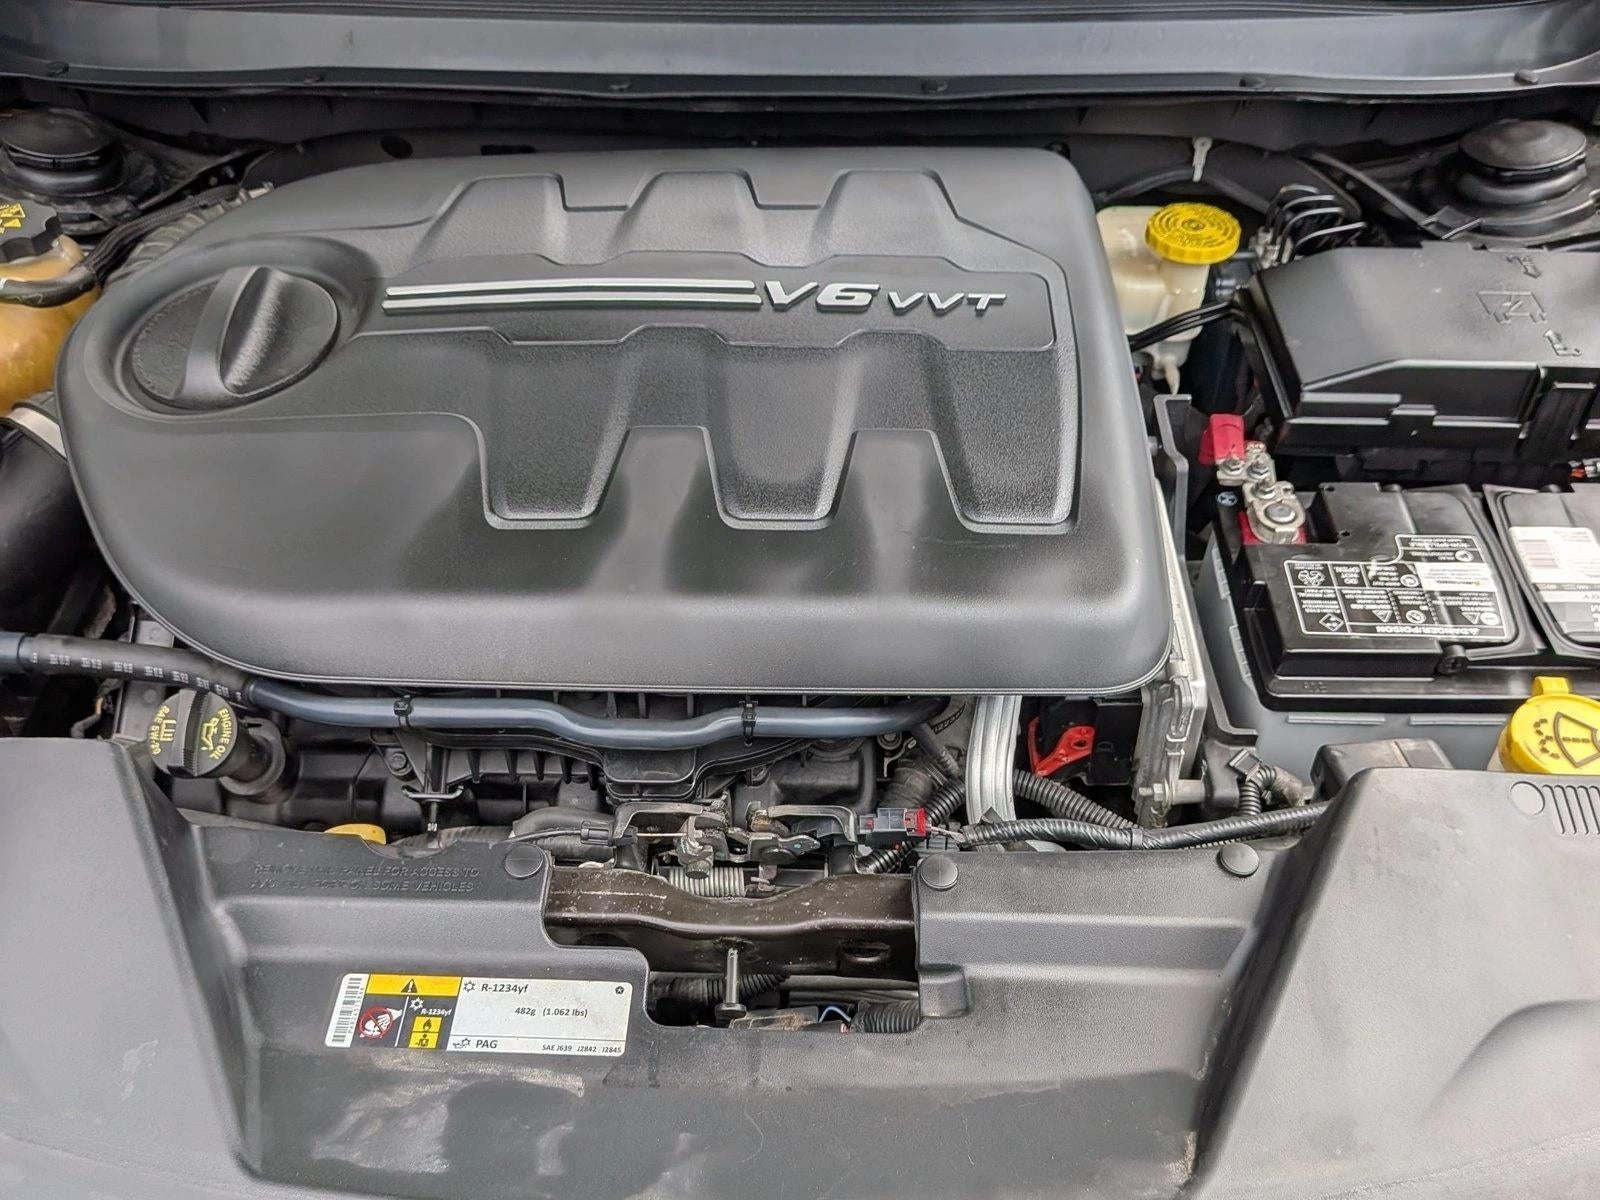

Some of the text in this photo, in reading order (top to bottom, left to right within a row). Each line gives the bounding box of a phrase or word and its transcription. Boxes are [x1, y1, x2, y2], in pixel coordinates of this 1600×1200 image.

[764, 280, 1007, 317] V6 VVT
[217, 708, 232, 745] ENGINE
[209, 744, 226, 760] OIL
[463, 867, 480, 878] TO
[416, 880, 475, 893] VEHICLES
[481, 983, 529, 994] R-1234yf
[514, 1006, 588, 1018] 482g (1.062 lbs)
[475, 1039, 498, 1049] PAG
[556, 1044, 573, 1052] J639
